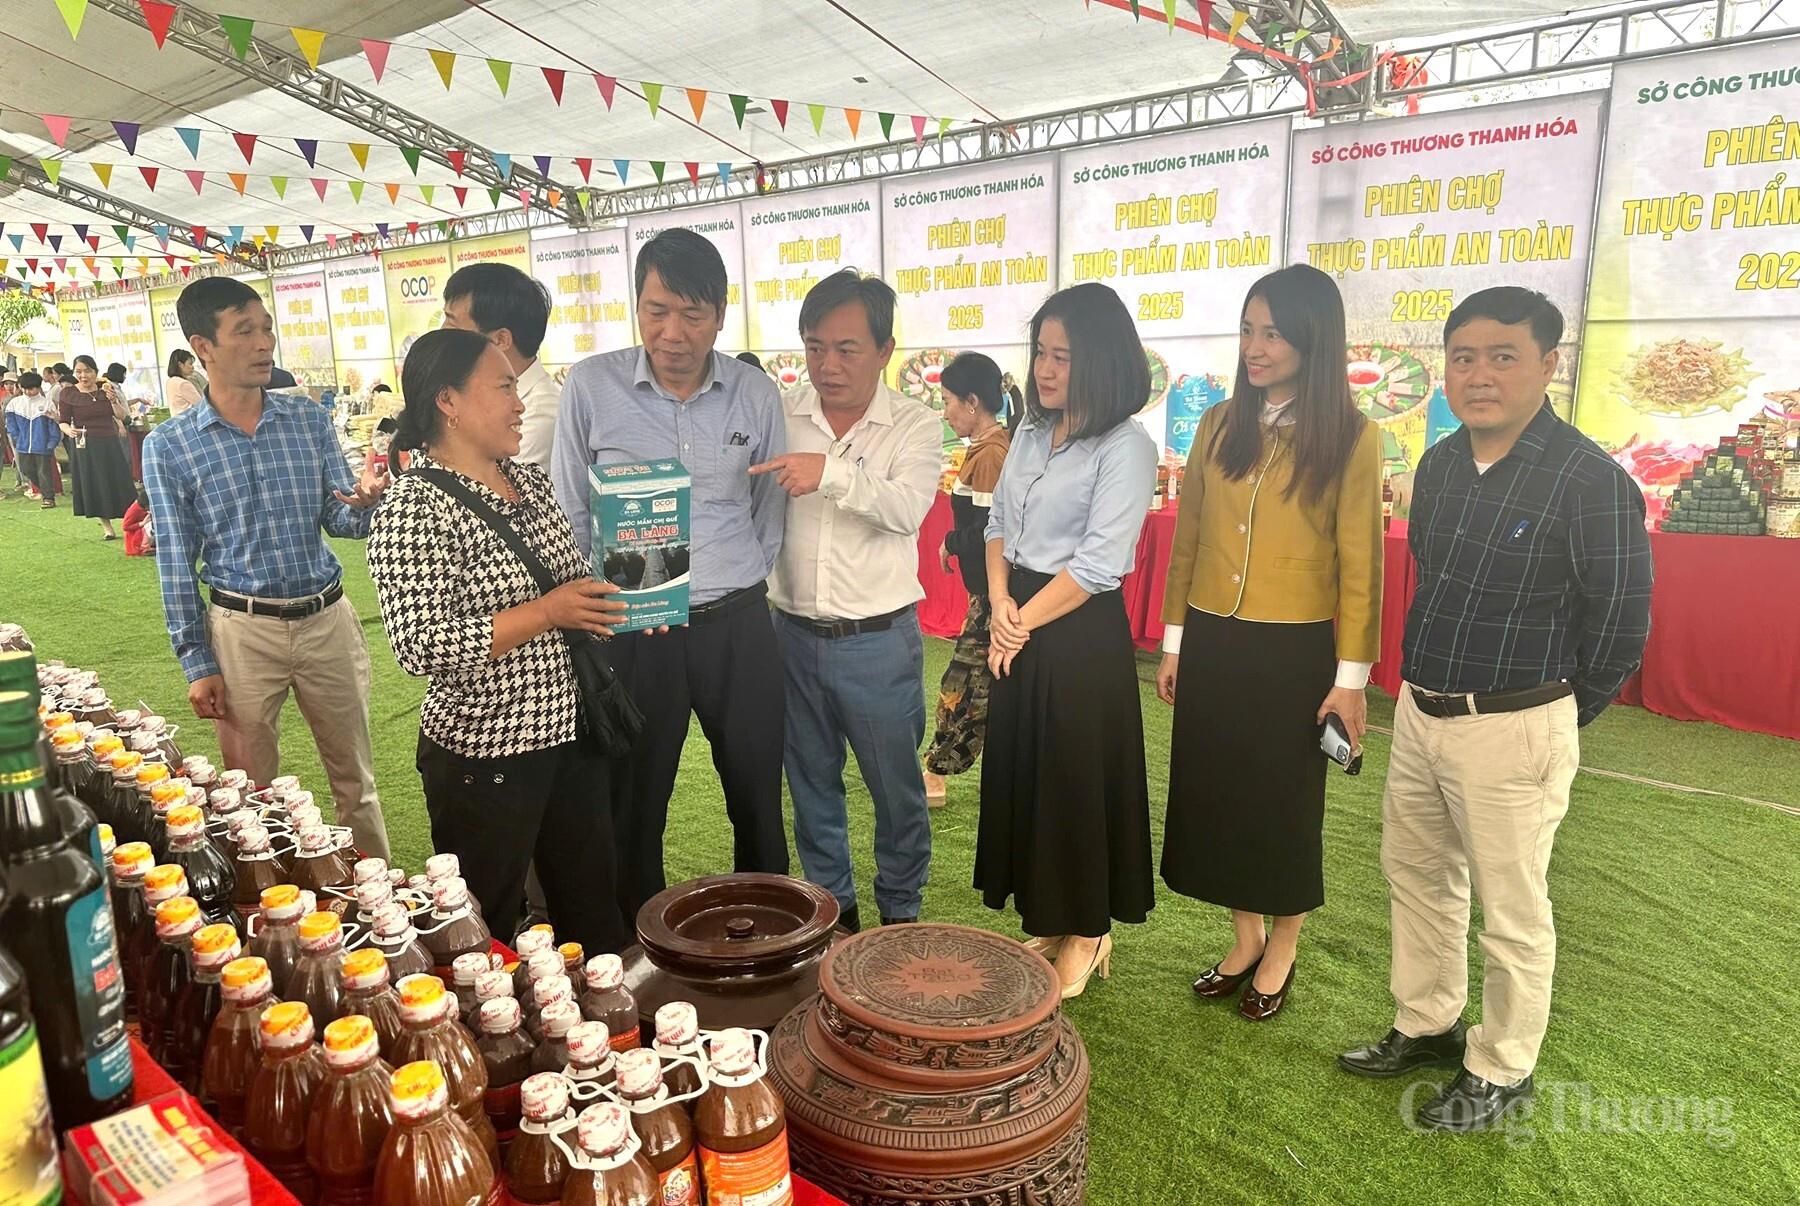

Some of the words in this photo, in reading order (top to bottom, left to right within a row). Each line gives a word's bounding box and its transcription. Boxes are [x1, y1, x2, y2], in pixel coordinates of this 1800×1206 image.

[1637, 80, 1670, 104] SỞ
[1673, 76, 1743, 99] CÔNG
[1312, 145, 1333, 164] SỞ
[1337, 142, 1387, 162] CÔNG
[1390, 133, 1465, 155] THƯƠNG
[1469, 124, 1531, 146] THANH
[1535, 117, 1578, 138] HÓA
[1073, 167, 1090, 184] SỞ
[1092, 164, 1130, 181] CÔNG
[1132, 156, 1187, 175] THƯƠNG
[1189, 149, 1235, 168] THANH
[1238, 142, 1270, 161] HÓA
[894, 193, 908, 208] SỞ
[909, 191, 937, 206] CÔNG
[939, 185, 982, 201] THƯƠNG
[983, 179, 1019, 195] THANH
[1020, 173, 1045, 189] HÓA
[1365, 174, 1441, 217] PHIÊN
[1447, 170, 1505, 215] CHỢ
[751, 213, 762, 226] SỞ
[763, 210, 786, 225] CÔNG
[787, 207, 821, 222] THƯƠNG
[822, 203, 850, 217] THANH
[851, 199, 871, 213] HÓA
[1115, 193, 1171, 231] PHIÊN
[1177, 188, 1219, 228] CHỢ
[1623, 192, 1703, 241] THỰC
[694, 222, 718, 233] THANH
[928, 217, 971, 250] PHIÊN
[975, 213, 1007, 248] CHỢ
[779, 235, 814, 265] PHIÊN
[816, 234, 842, 264] CHỢ
[1073, 248, 1117, 281] THỰC
[1122, 234, 1177, 276] PHẨM
[1181, 241, 1210, 271] AN
[1215, 231, 1271, 269] TOÀN
[1307, 238, 1366, 279] THỰC
[1371, 223, 1447, 270] PHẨM
[1451, 231, 1492, 265] AN
[1498, 220, 1574, 263] TOÀN
[401, 276, 436, 297] OCOP
[896, 266, 931, 298] THỰC
[934, 254, 977, 290] PHẨM
[980, 260, 1002, 287] AN
[1005, 252, 1048, 284] TOÀN
[948, 304, 984, 330] 2025
[1138, 292, 1184, 321] 2025
[1391, 289, 1453, 322] 2025
[654, 499, 675, 507] OCOP
[617, 520, 636, 528] NƯỚC
[617, 528, 638, 541] BA
